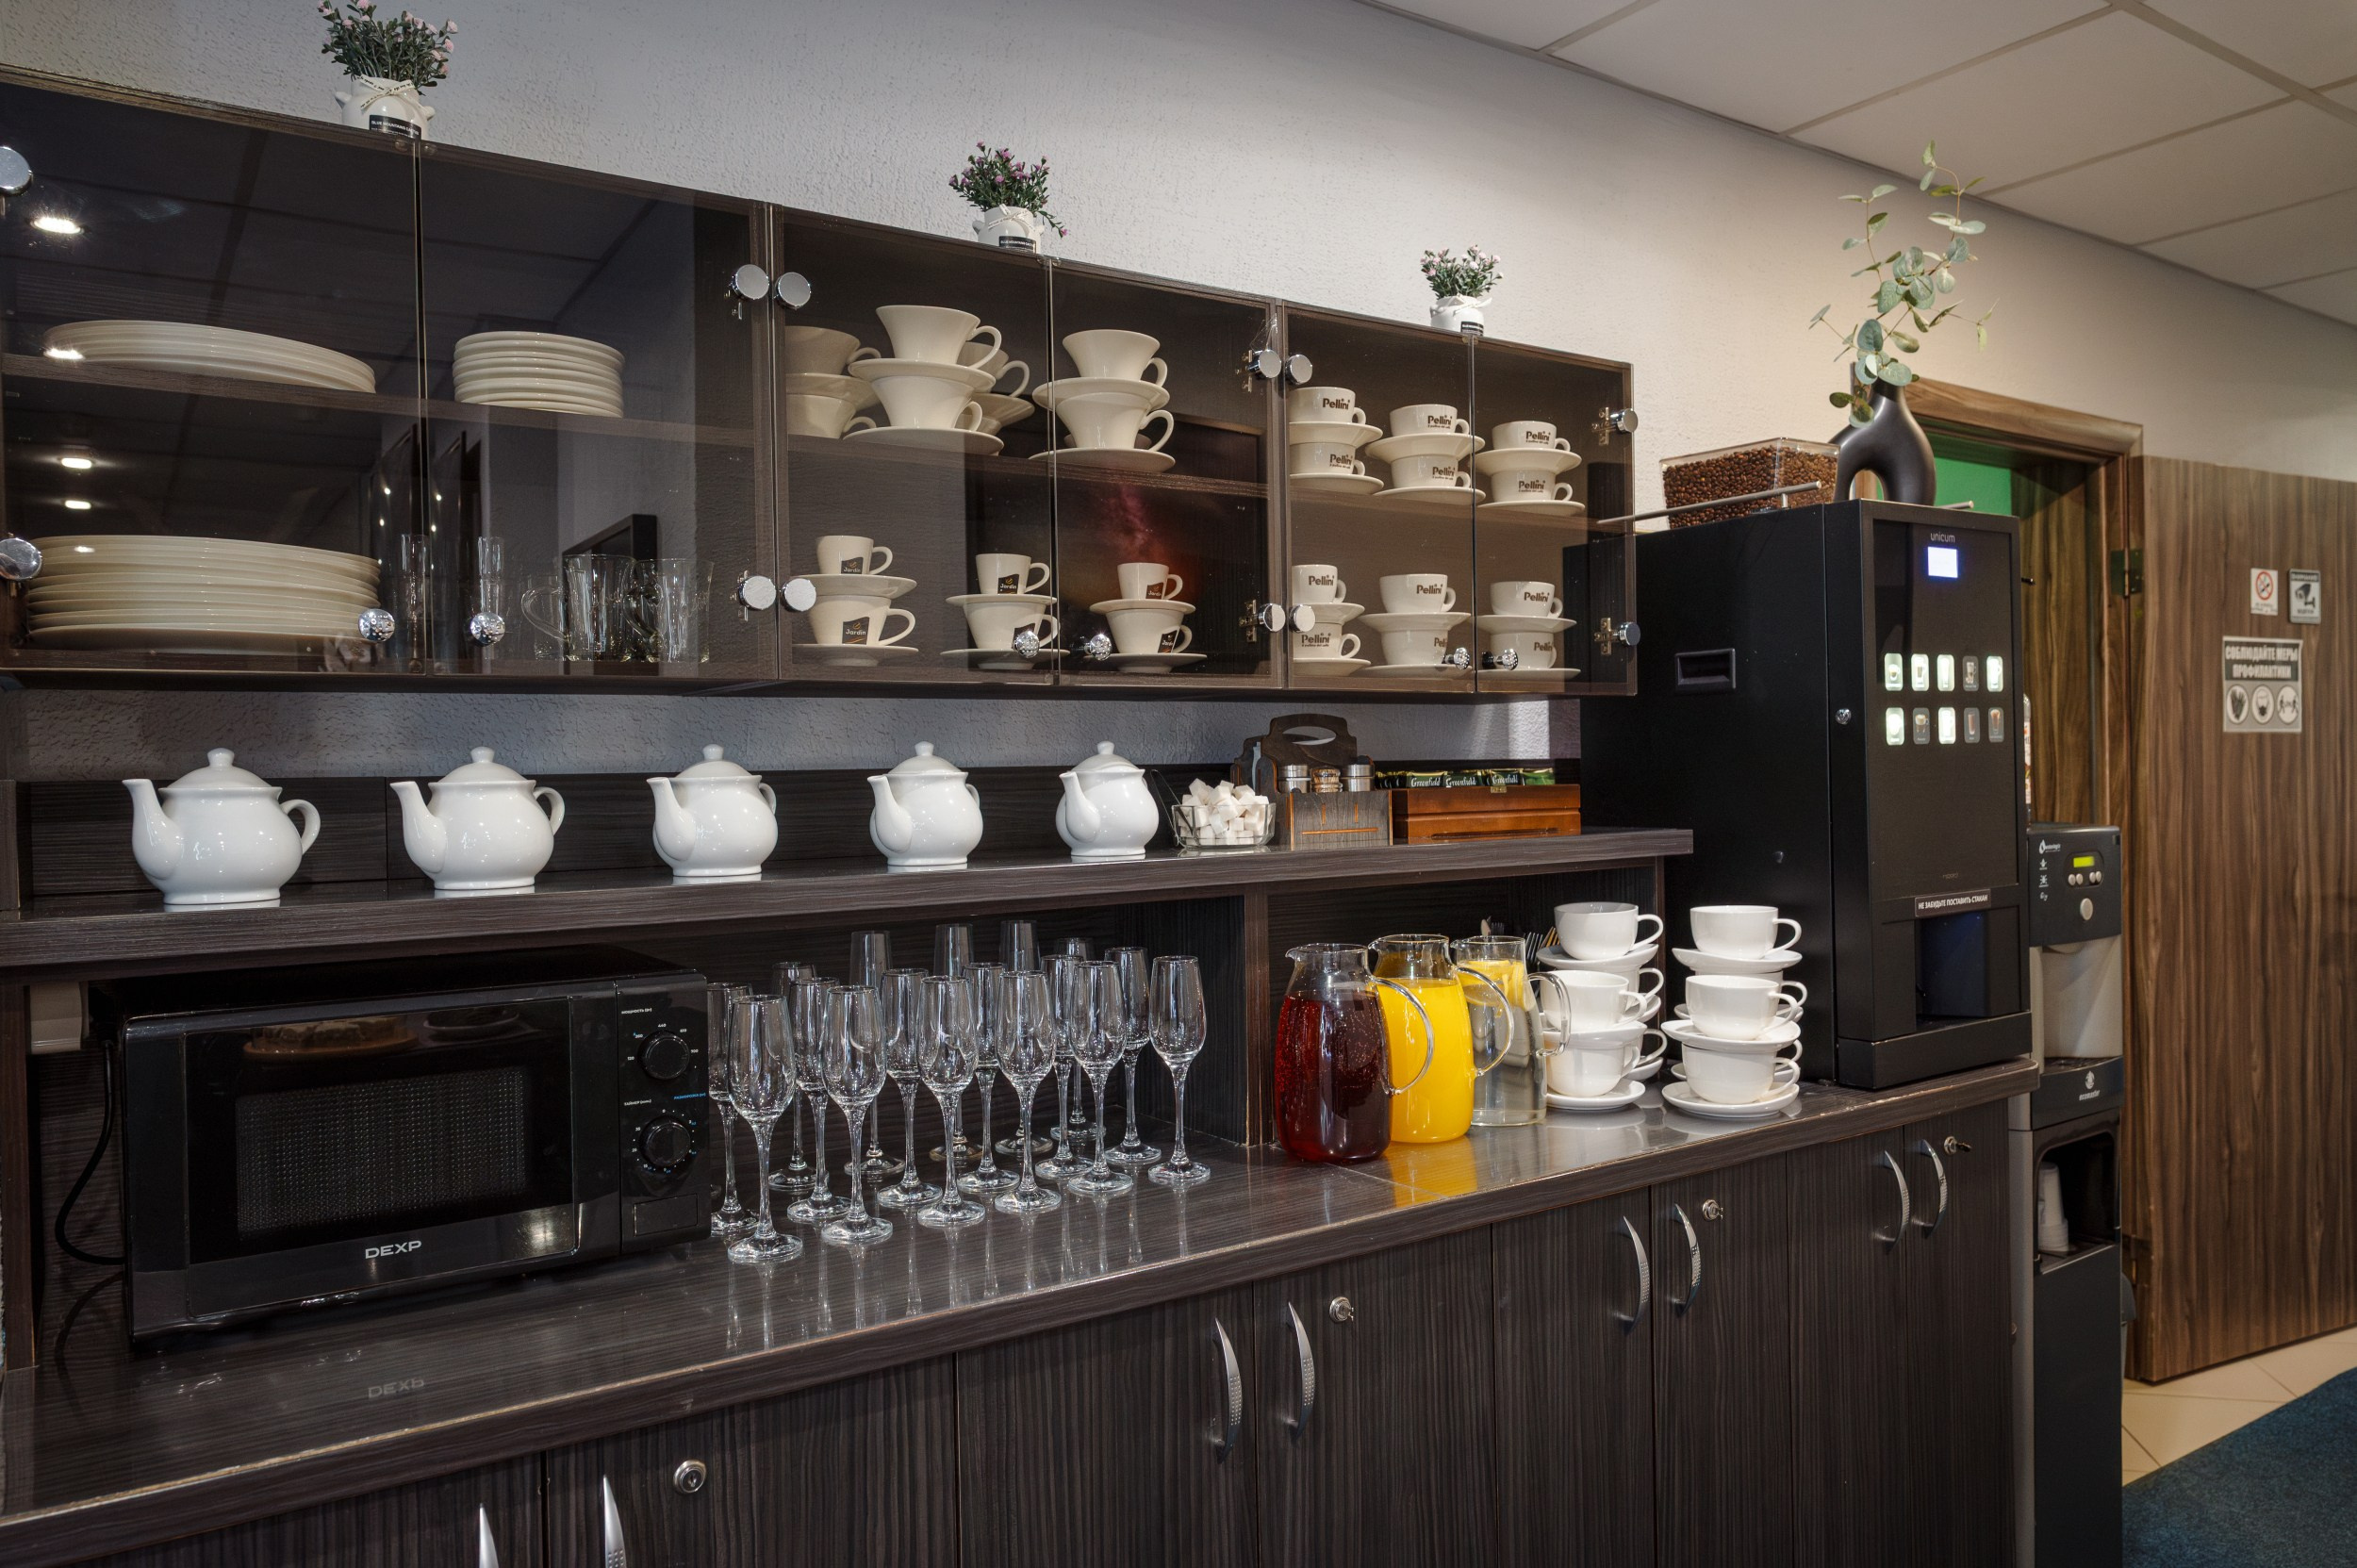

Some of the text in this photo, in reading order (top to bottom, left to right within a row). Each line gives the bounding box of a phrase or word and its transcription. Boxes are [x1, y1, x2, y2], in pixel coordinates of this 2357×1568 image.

[1323, 398, 1350, 410] Pellini
[1427, 415, 1453, 425] Pellini
[1525, 430, 1551, 441] Pellini
[1329, 454, 1354, 467] Pellini
[1432, 466, 1456, 476] Pellini
[1518, 479, 1545, 489] Pellini
[1930, 532, 1956, 543] unicum
[1308, 575, 1335, 586] Pellini
[1416, 584, 1443, 594] Pellini
[1524, 591, 1550, 602] Pellini
[1301, 633, 1331, 644] Pellini
[2225, 645, 2299, 662] СОБЛЮДАЙТЕ МЕРЫ
[2233, 664, 2292, 679] ПРОФИЛАКТИКИ
[1410, 777, 1441, 787] Greenfield
[1445, 777, 1477, 788] Greenfield
[1492, 774, 1519, 785] Greenfield
[1924, 899, 1947, 909] ЗАБУДЬТЕ
[1946, 897, 1972, 907] ПОСТАВИТЬ
[1971, 894, 1988, 903] СТАКАН
[365, 1240, 422, 1260] DEXP
